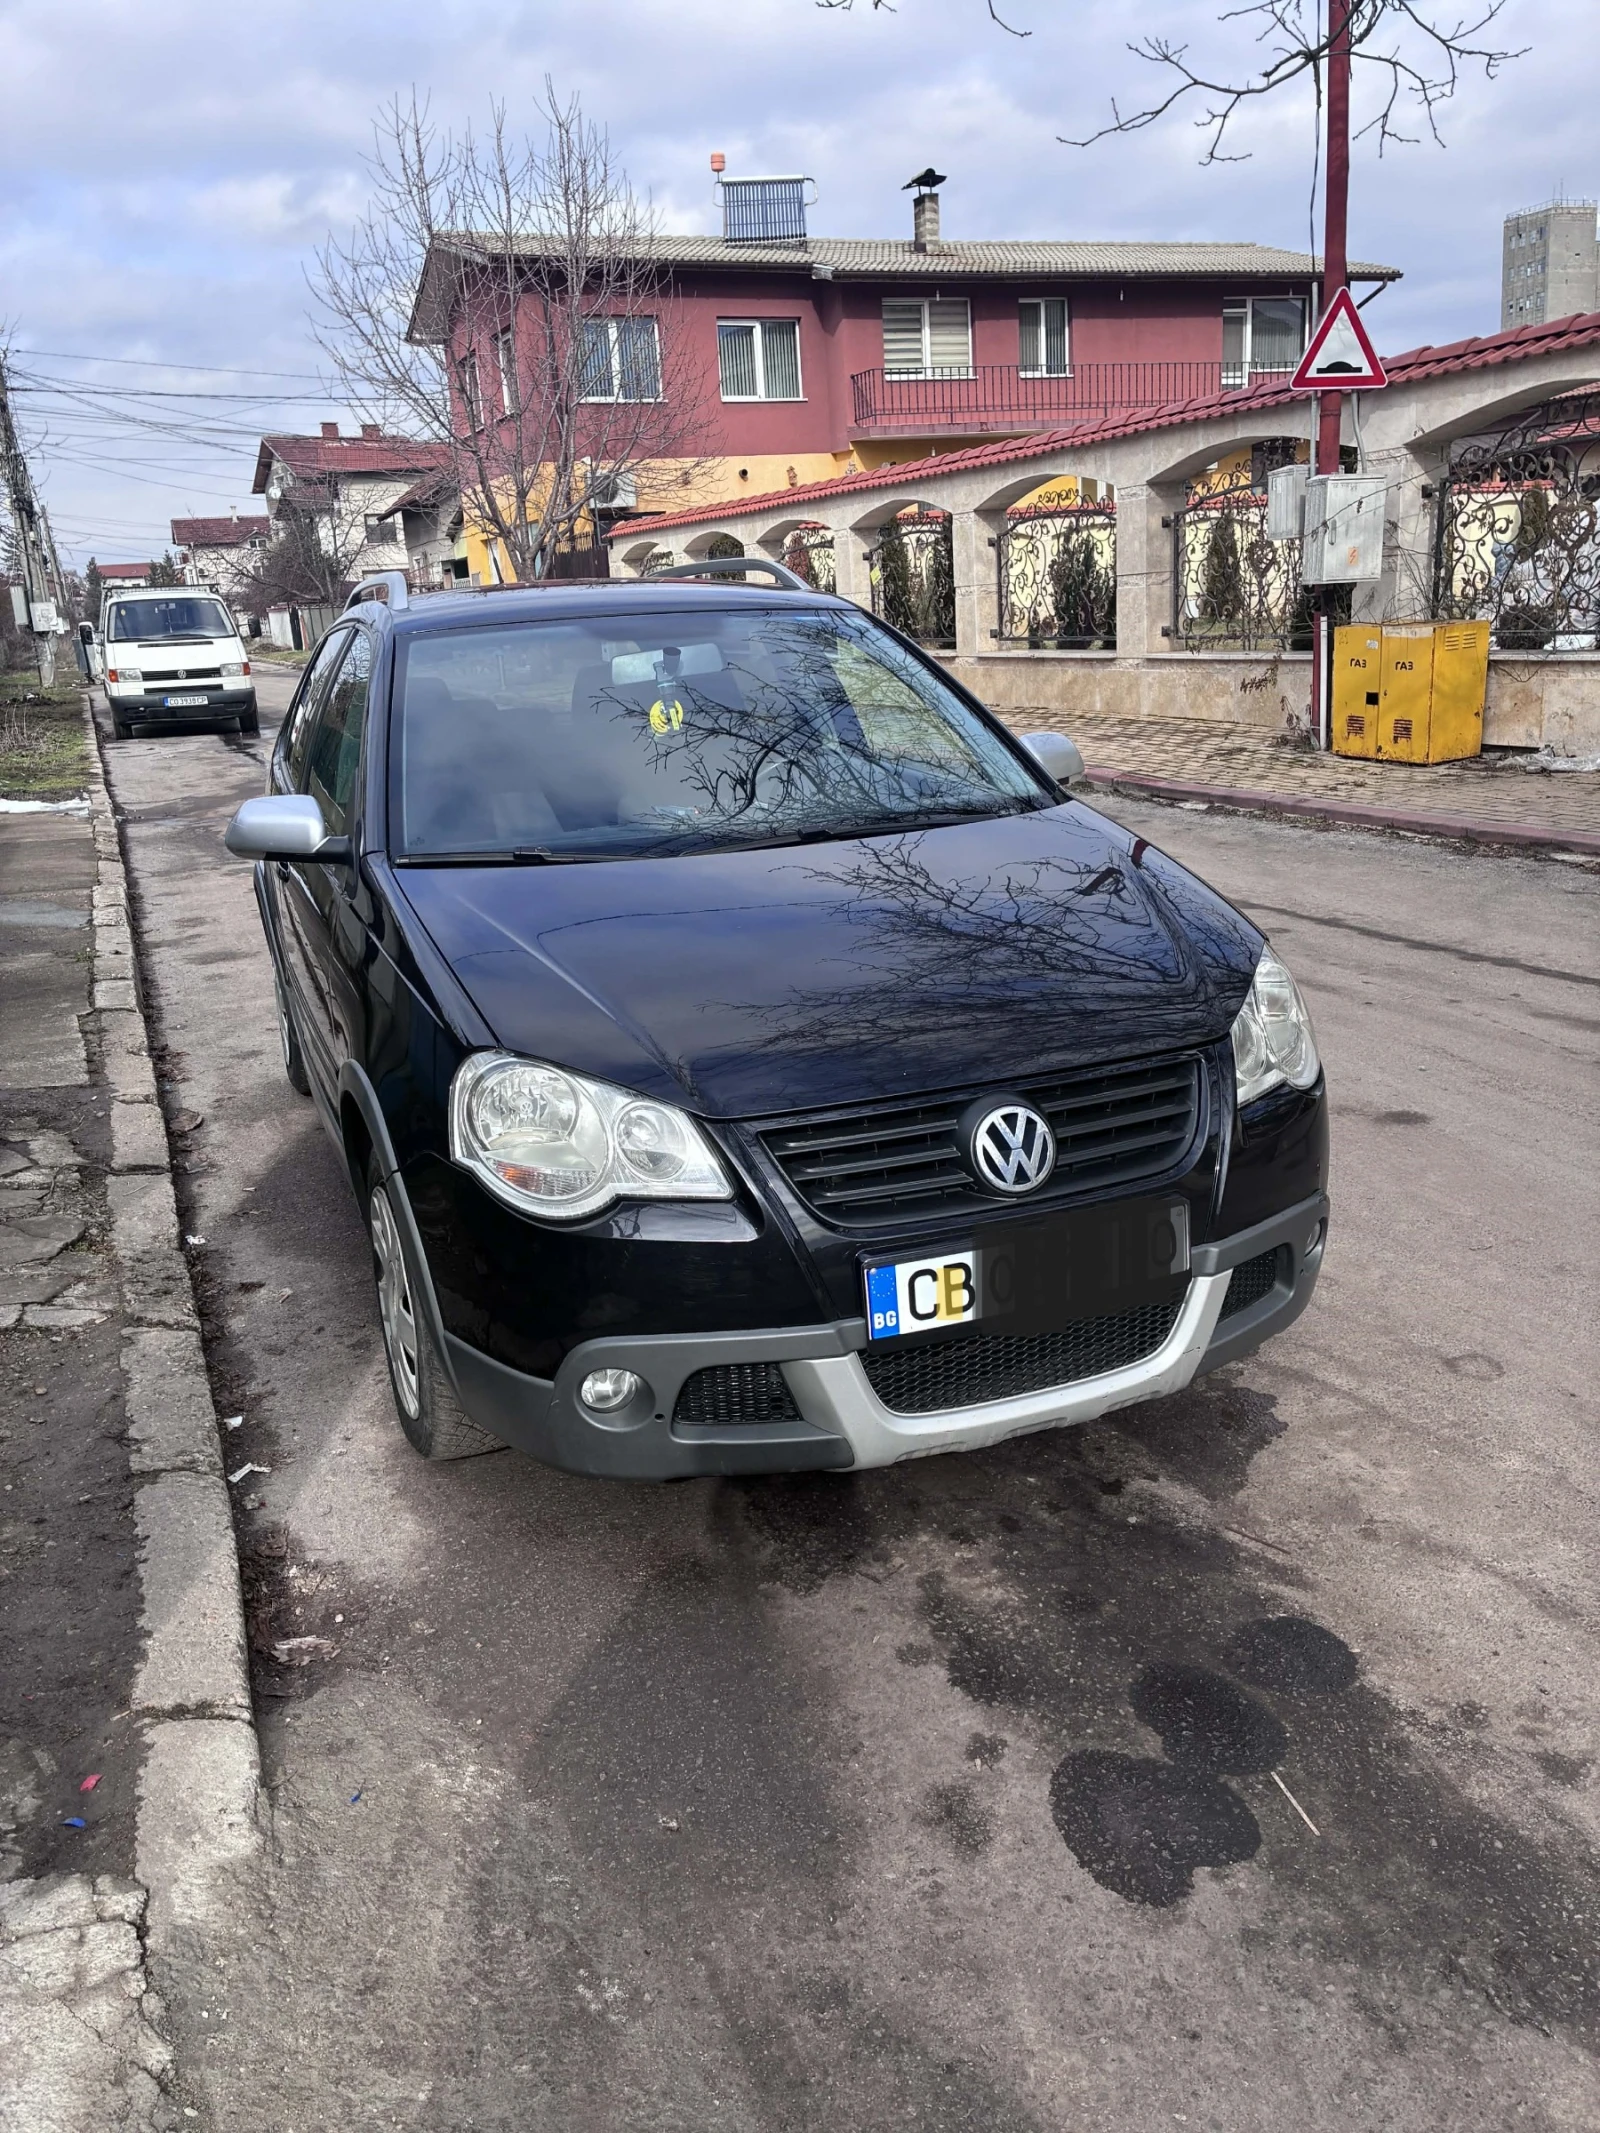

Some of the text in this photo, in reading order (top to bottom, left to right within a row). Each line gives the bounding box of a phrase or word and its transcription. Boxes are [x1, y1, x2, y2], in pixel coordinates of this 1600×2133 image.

[1350, 658, 1367, 669] ГАЗ
[1395, 661, 1414, 671] ГАЗ
[975, 1105, 1054, 1192] VW
[908, 1262, 976, 1321] CB
[873, 1310, 897, 1330] BG
